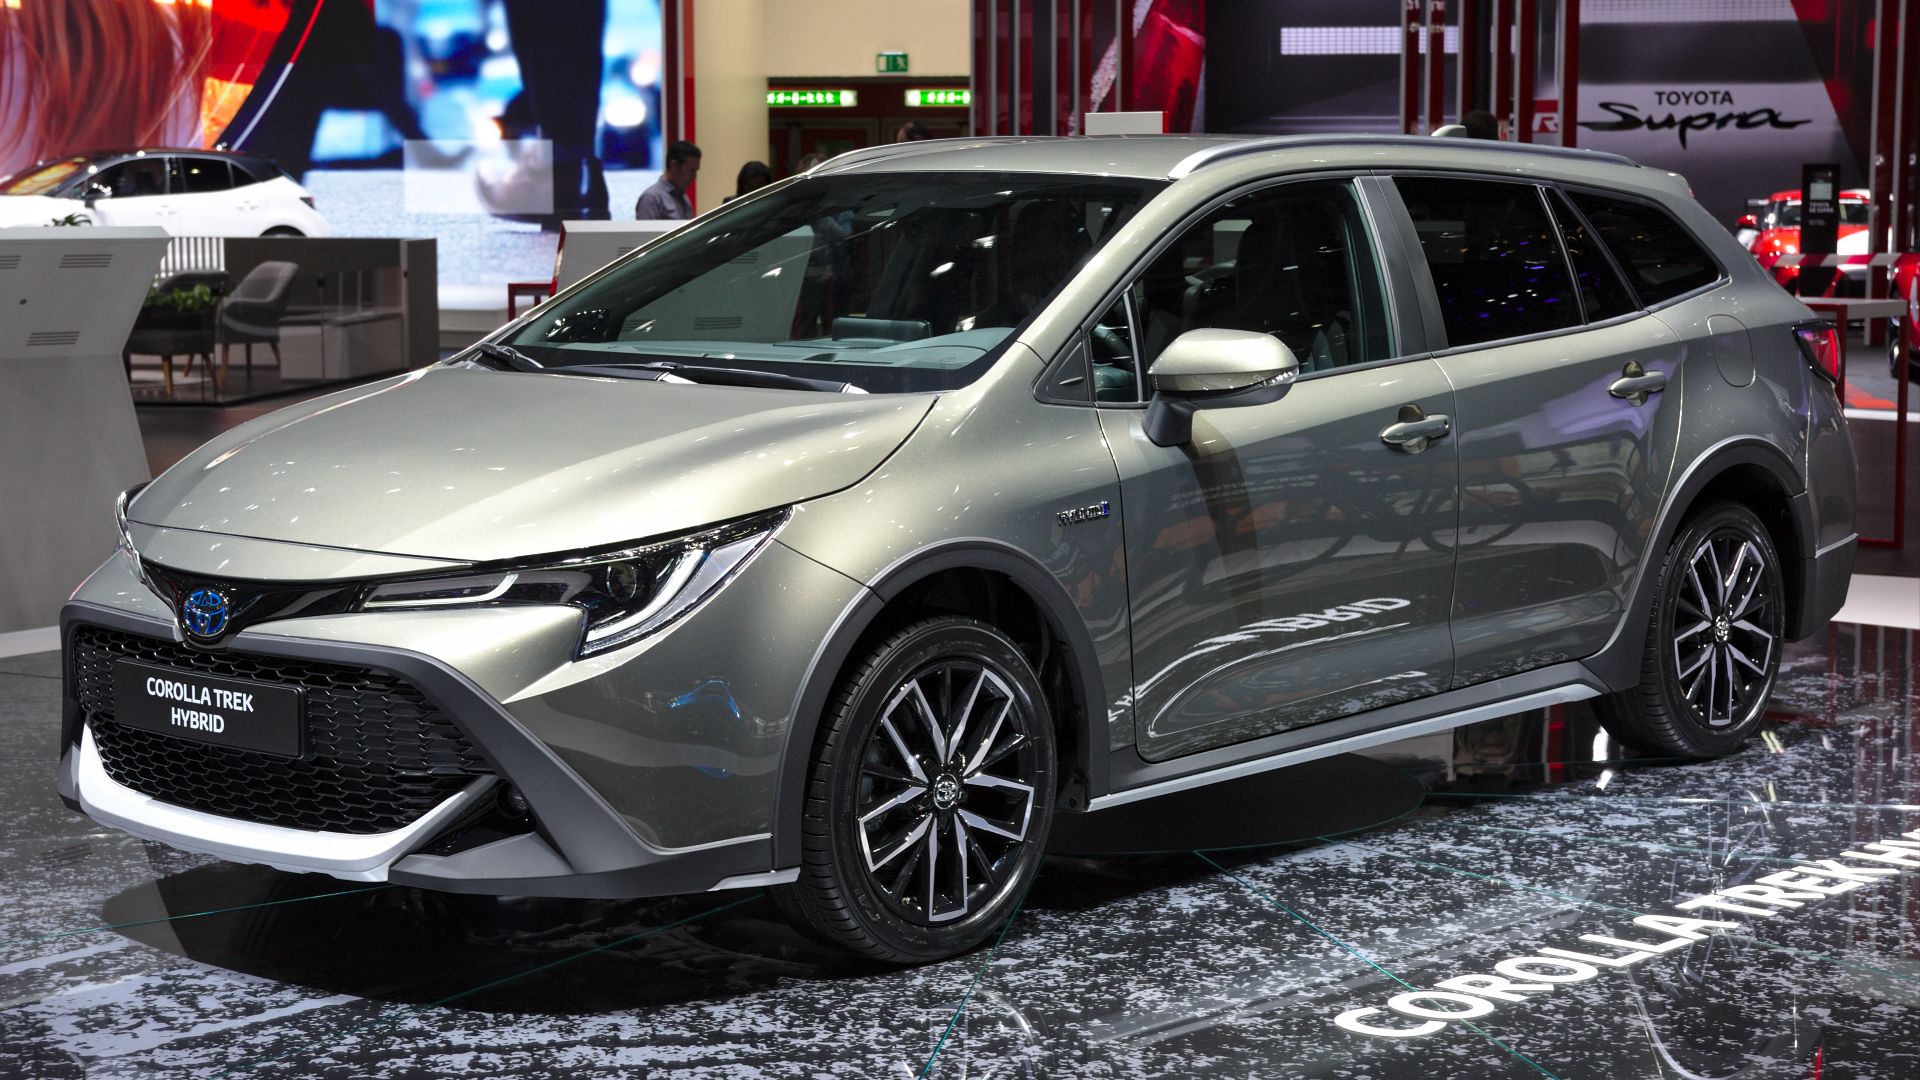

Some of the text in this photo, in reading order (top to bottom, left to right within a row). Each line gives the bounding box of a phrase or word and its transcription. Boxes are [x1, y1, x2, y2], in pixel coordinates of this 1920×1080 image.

[1655, 91, 1734, 106] TOYOTA
[1578, 102, 1813, 150] Supra
[146, 677, 254, 713] COROLLA TREK
[171, 707, 225, 733] HYBRID
[1334, 914, 1741, 1038] COROLLA
[1674, 859, 1900, 917] TREK
